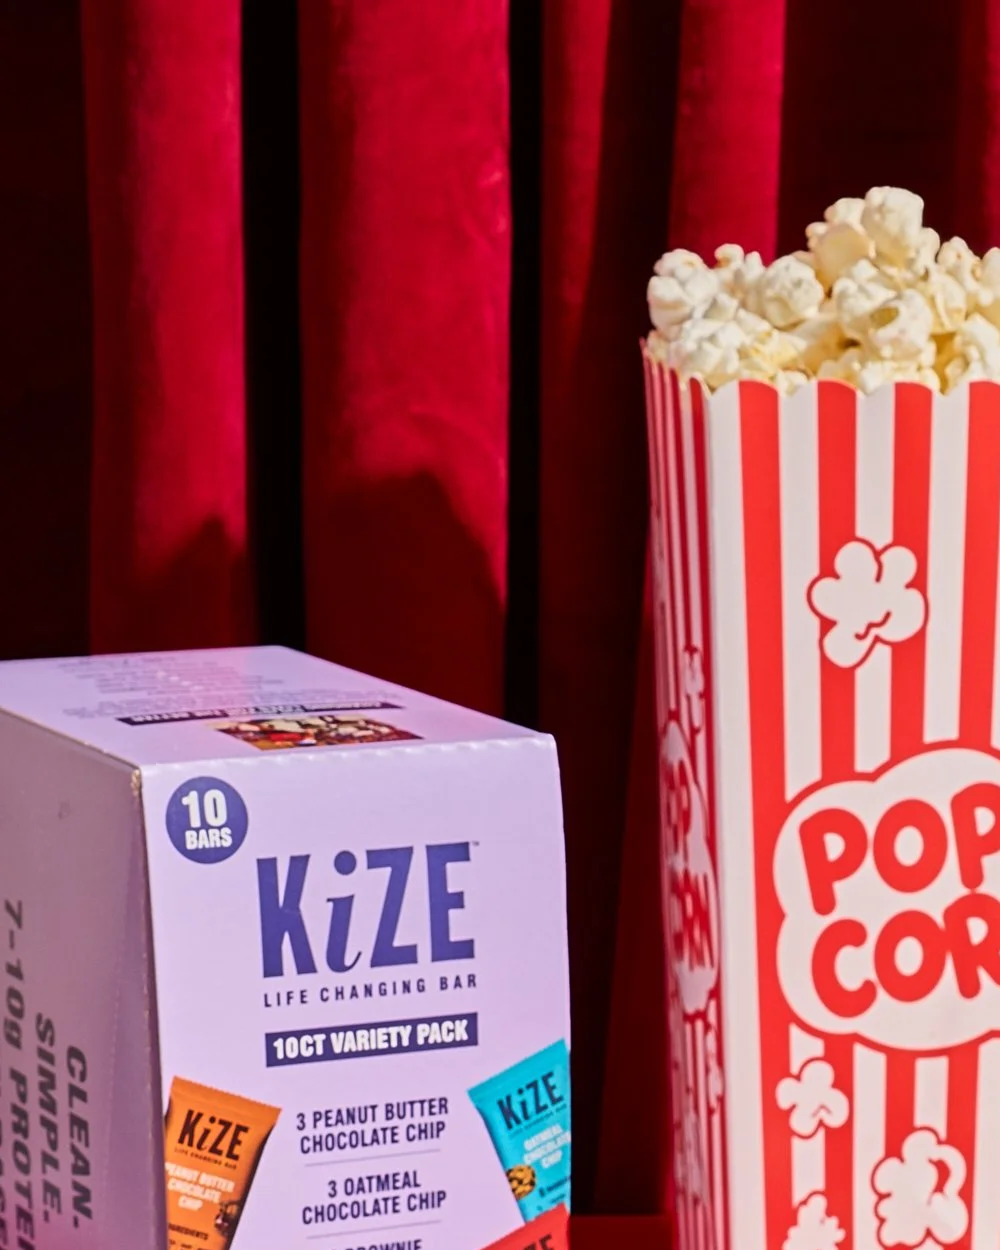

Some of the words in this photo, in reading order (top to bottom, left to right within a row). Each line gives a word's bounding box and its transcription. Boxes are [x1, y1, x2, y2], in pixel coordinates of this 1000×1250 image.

[181, 788, 228, 829] 10
[184, 827, 233, 851] BARS
[256, 841, 475, 978] KiZE
[264, 990, 308, 1007] LIFE
[320, 978, 426, 1002] CHANGING
[440, 974, 477, 991] BAR
[273, 1033, 326, 1060] 10CT
[330, 1025, 412, 1054] VARIETY
[416, 1019, 468, 1045] PACK
[36, 1012, 62, 1223] SIMPLE.
[296, 1112, 306, 1131] 3
[313, 1104, 378, 1128] PEANUT
[385, 1097, 449, 1121] BUTTER
[497, 1071, 564, 1130] KiZE
[66, 1045, 93, 1229] CLEAN.
[178, 1109, 249, 1161] KiZE
[300, 1126, 399, 1154] CHOCOLATE
[406, 1121, 445, 1142] CHIP
[328, 1180, 337, 1198] 3
[344, 1170, 421, 1196] OATMEAL
[302, 1196, 401, 1225] CHOCOLATE
[407, 1190, 447, 1212] CHIP
